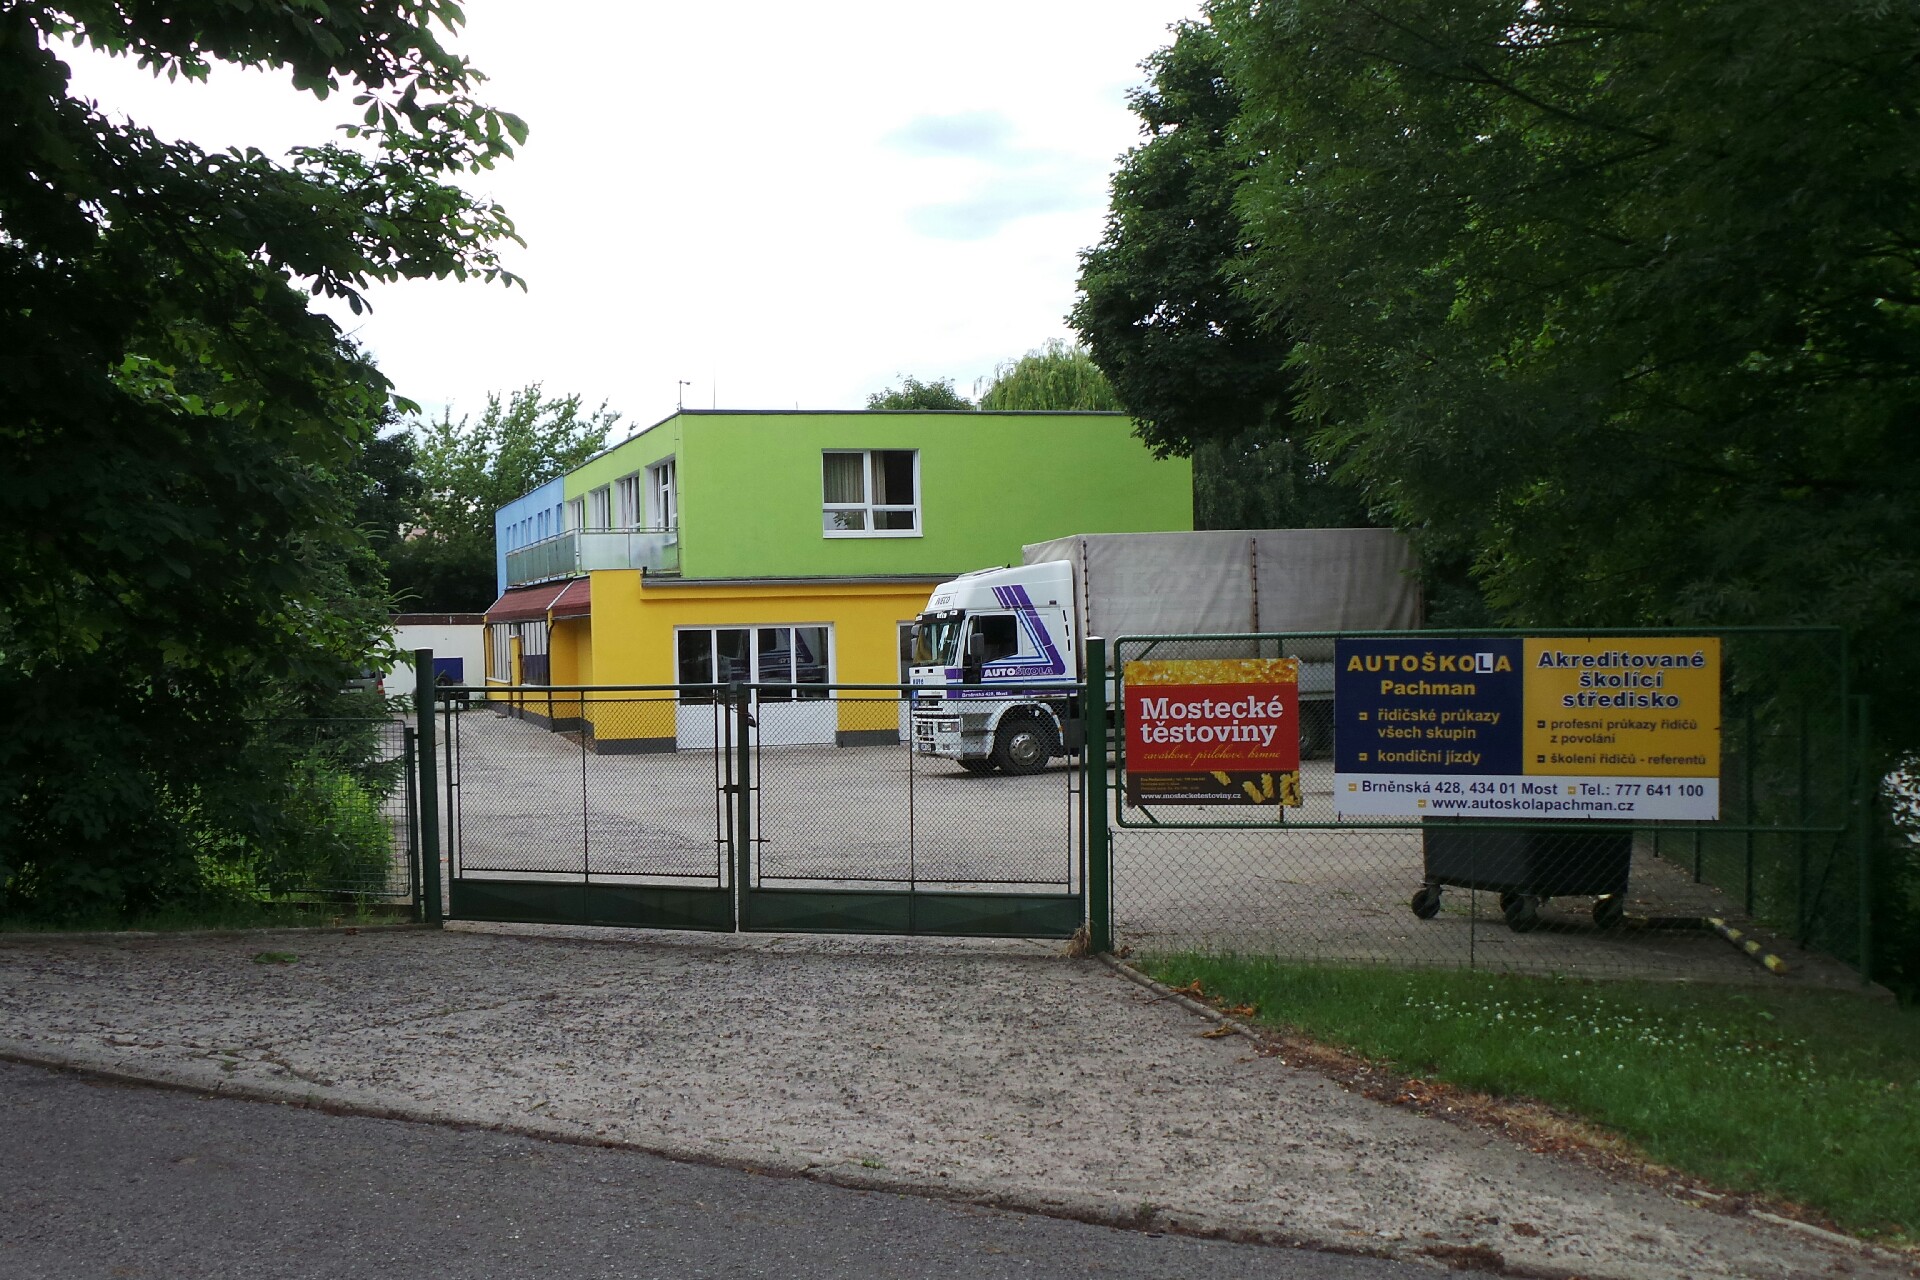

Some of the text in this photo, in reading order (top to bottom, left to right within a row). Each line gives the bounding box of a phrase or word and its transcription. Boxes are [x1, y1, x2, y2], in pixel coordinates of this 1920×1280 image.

[935, 596, 951, 605] IVECO
[1347, 652, 1512, 673] AUTOŠKOLA
[1537, 651, 1705, 668] Akreditované
[983, 665, 1055, 678] AUTOŠKOLA
[1579, 671, 1664, 688] školící
[1380, 680, 1476, 695] Pachman
[1561, 691, 1681, 708] středisko
[1140, 695, 1284, 720] Mostecké
[1377, 709, 1500, 725] řidičské průkazy
[1551, 719, 1697, 732] profesní průkazy řidičů
[1140, 720, 1278, 747] těstoviny
[1378, 726, 1477, 741] všech skupin
[1550, 733, 1616, 746] z povolání
[1377, 750, 1481, 765] kondiční jízdy
[1550, 753, 1596, 764] školení
[1599, 754, 1636, 764] řidičů
[1648, 755, 1706, 765] referentů
[1140, 791, 1242, 800] www.mostecketestoviny.cz
[1362, 780, 1704, 797] Brněnská 428, 434 01 Most Tel.: 777 641 100
[1432, 798, 1635, 813] www.autoskolapachman.cz
